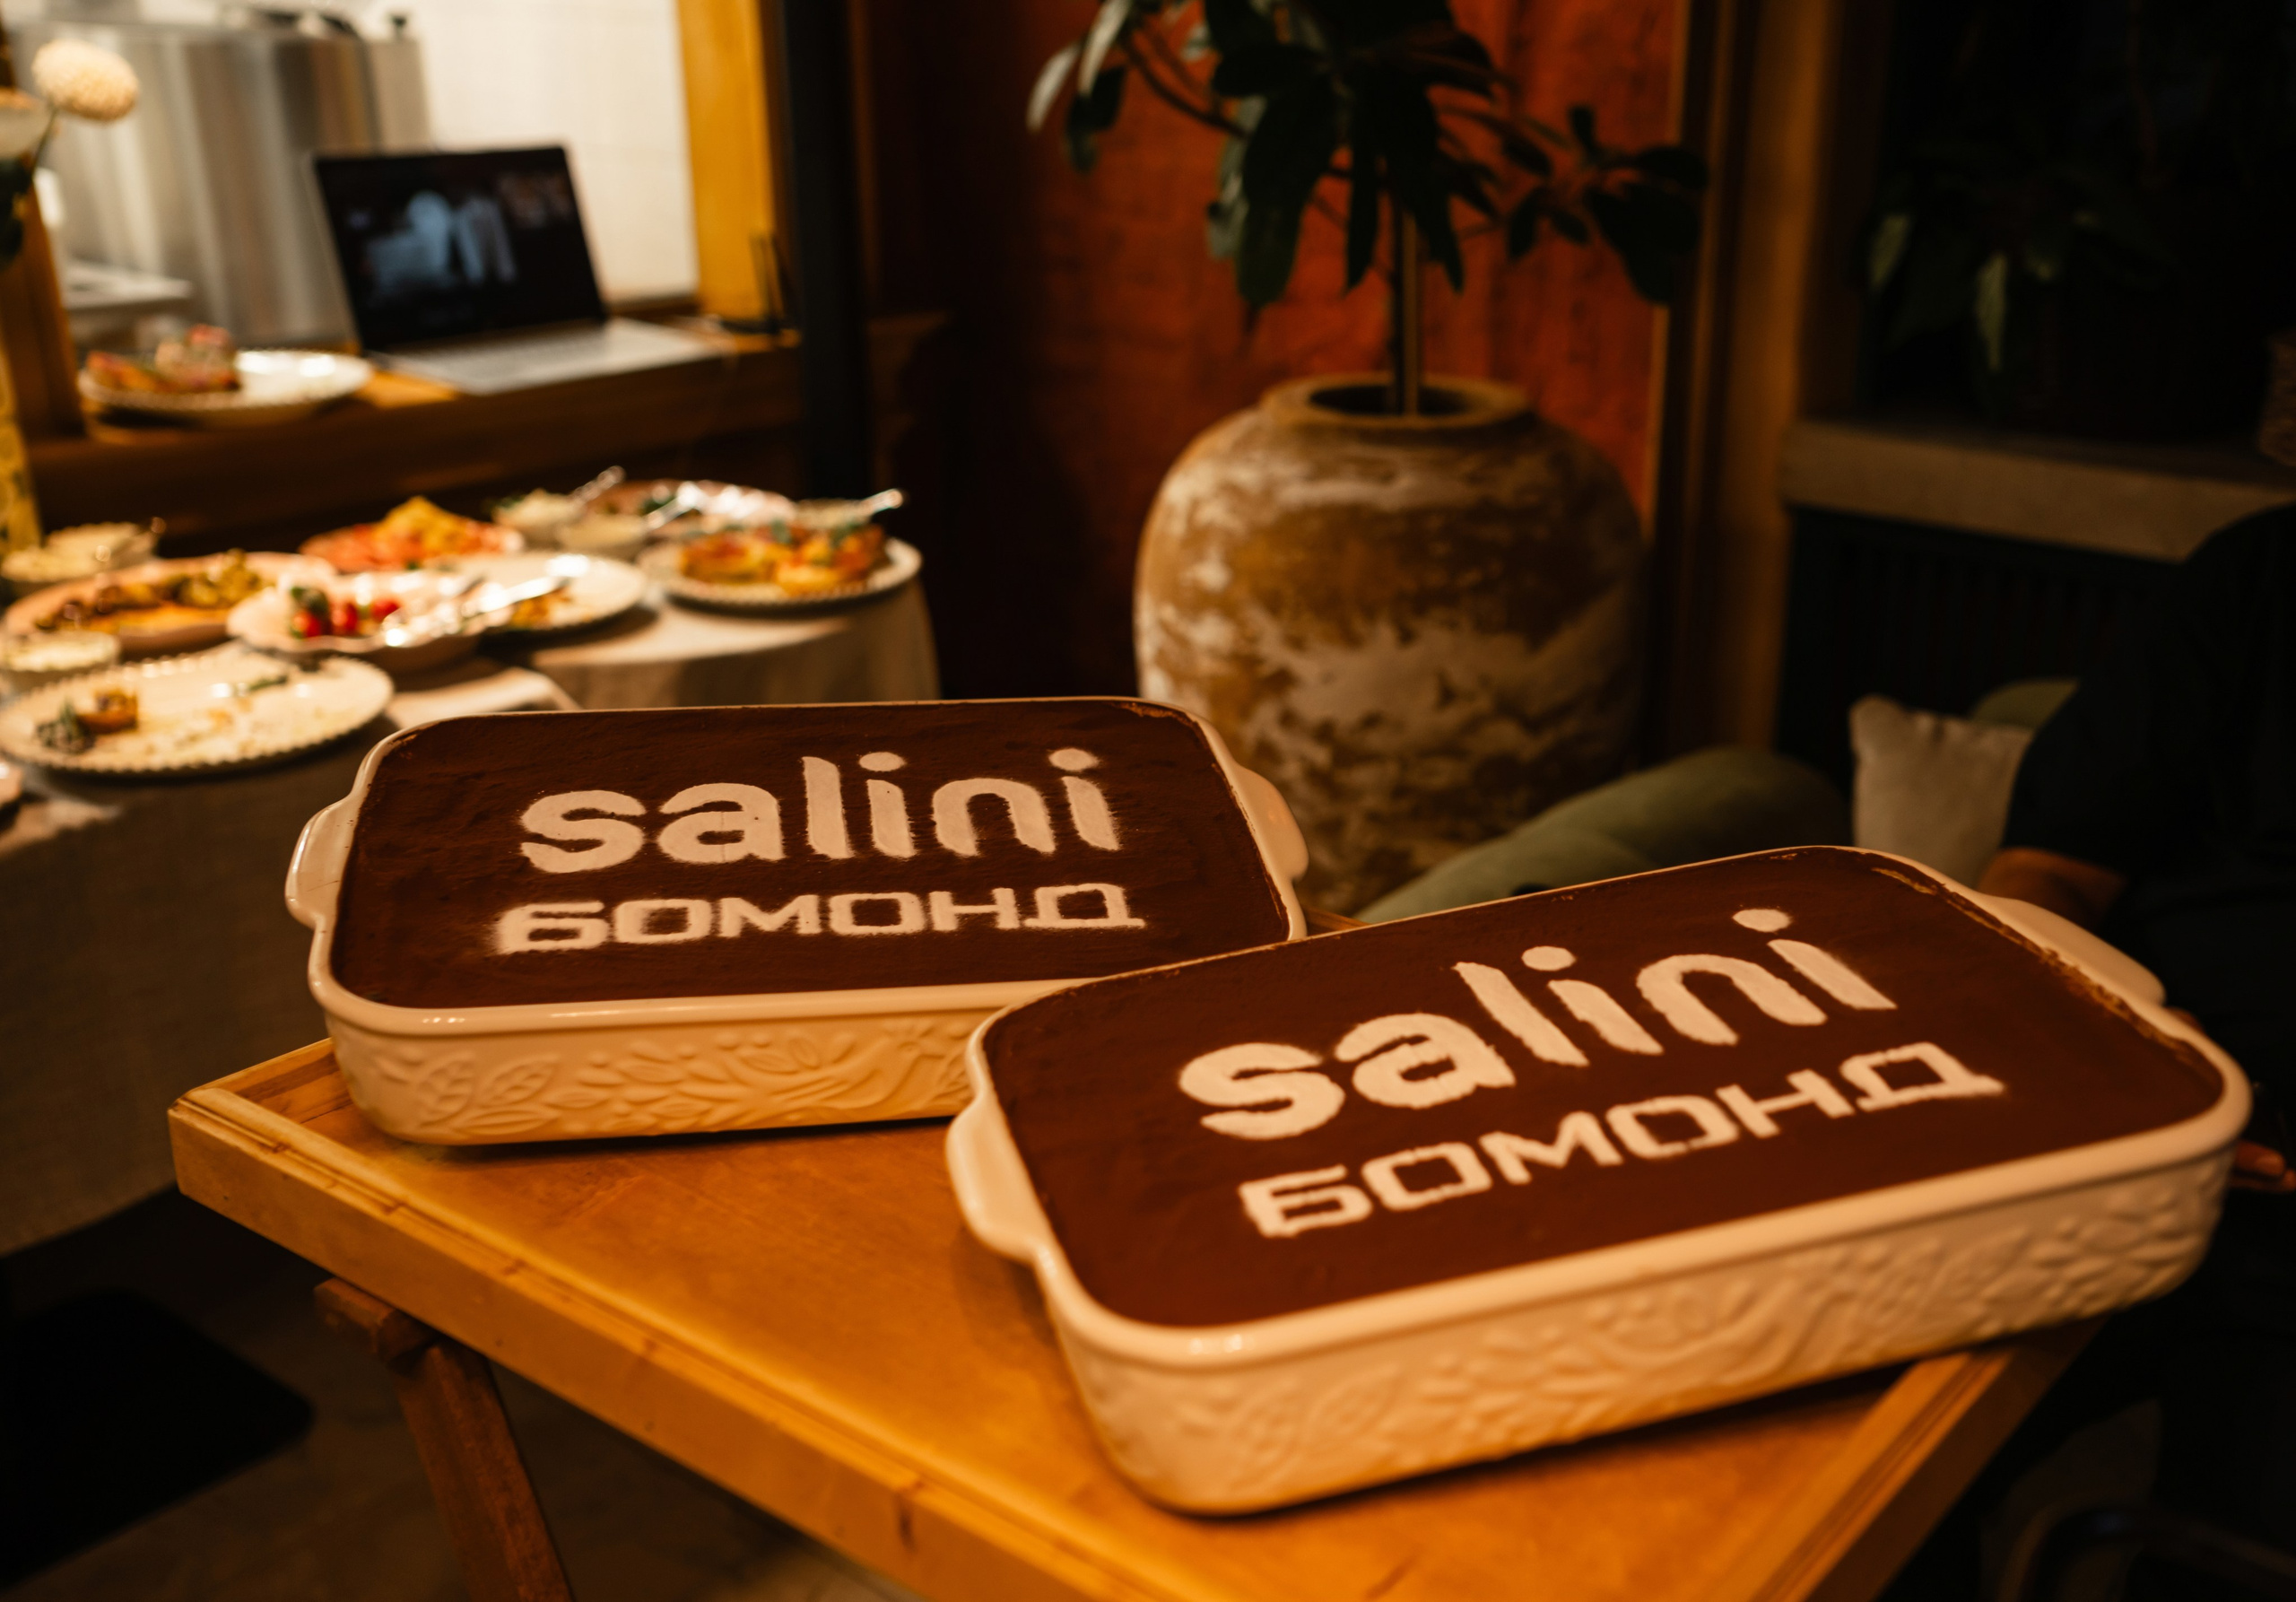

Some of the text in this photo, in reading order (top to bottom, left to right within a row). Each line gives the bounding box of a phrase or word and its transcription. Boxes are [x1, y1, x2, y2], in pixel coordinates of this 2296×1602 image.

[520, 748, 1121, 874] salini
[494, 883, 1146, 954] БОМОНД
[1178, 909, 1896, 1139] salini
[1239, 1042, 2004, 1236] БОМОНД
